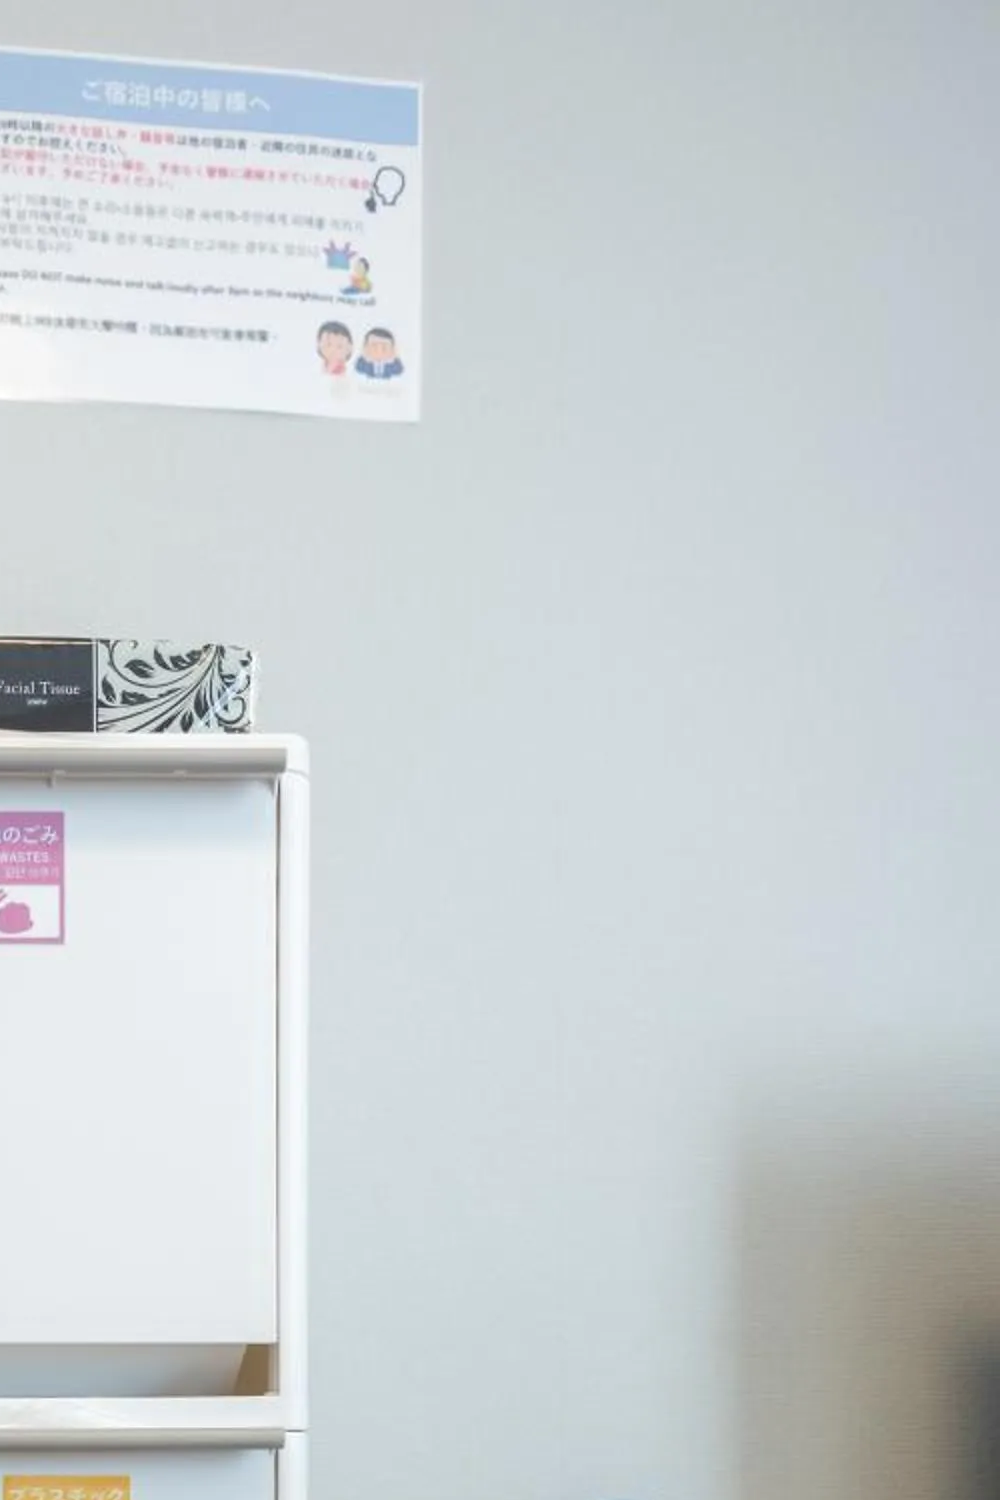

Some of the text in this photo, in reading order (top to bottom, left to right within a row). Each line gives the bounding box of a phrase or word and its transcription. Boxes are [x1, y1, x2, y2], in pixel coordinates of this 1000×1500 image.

[81, 79, 271, 113] ご宿泊中の皆様へ
[39, 680, 81, 696] Tissue
